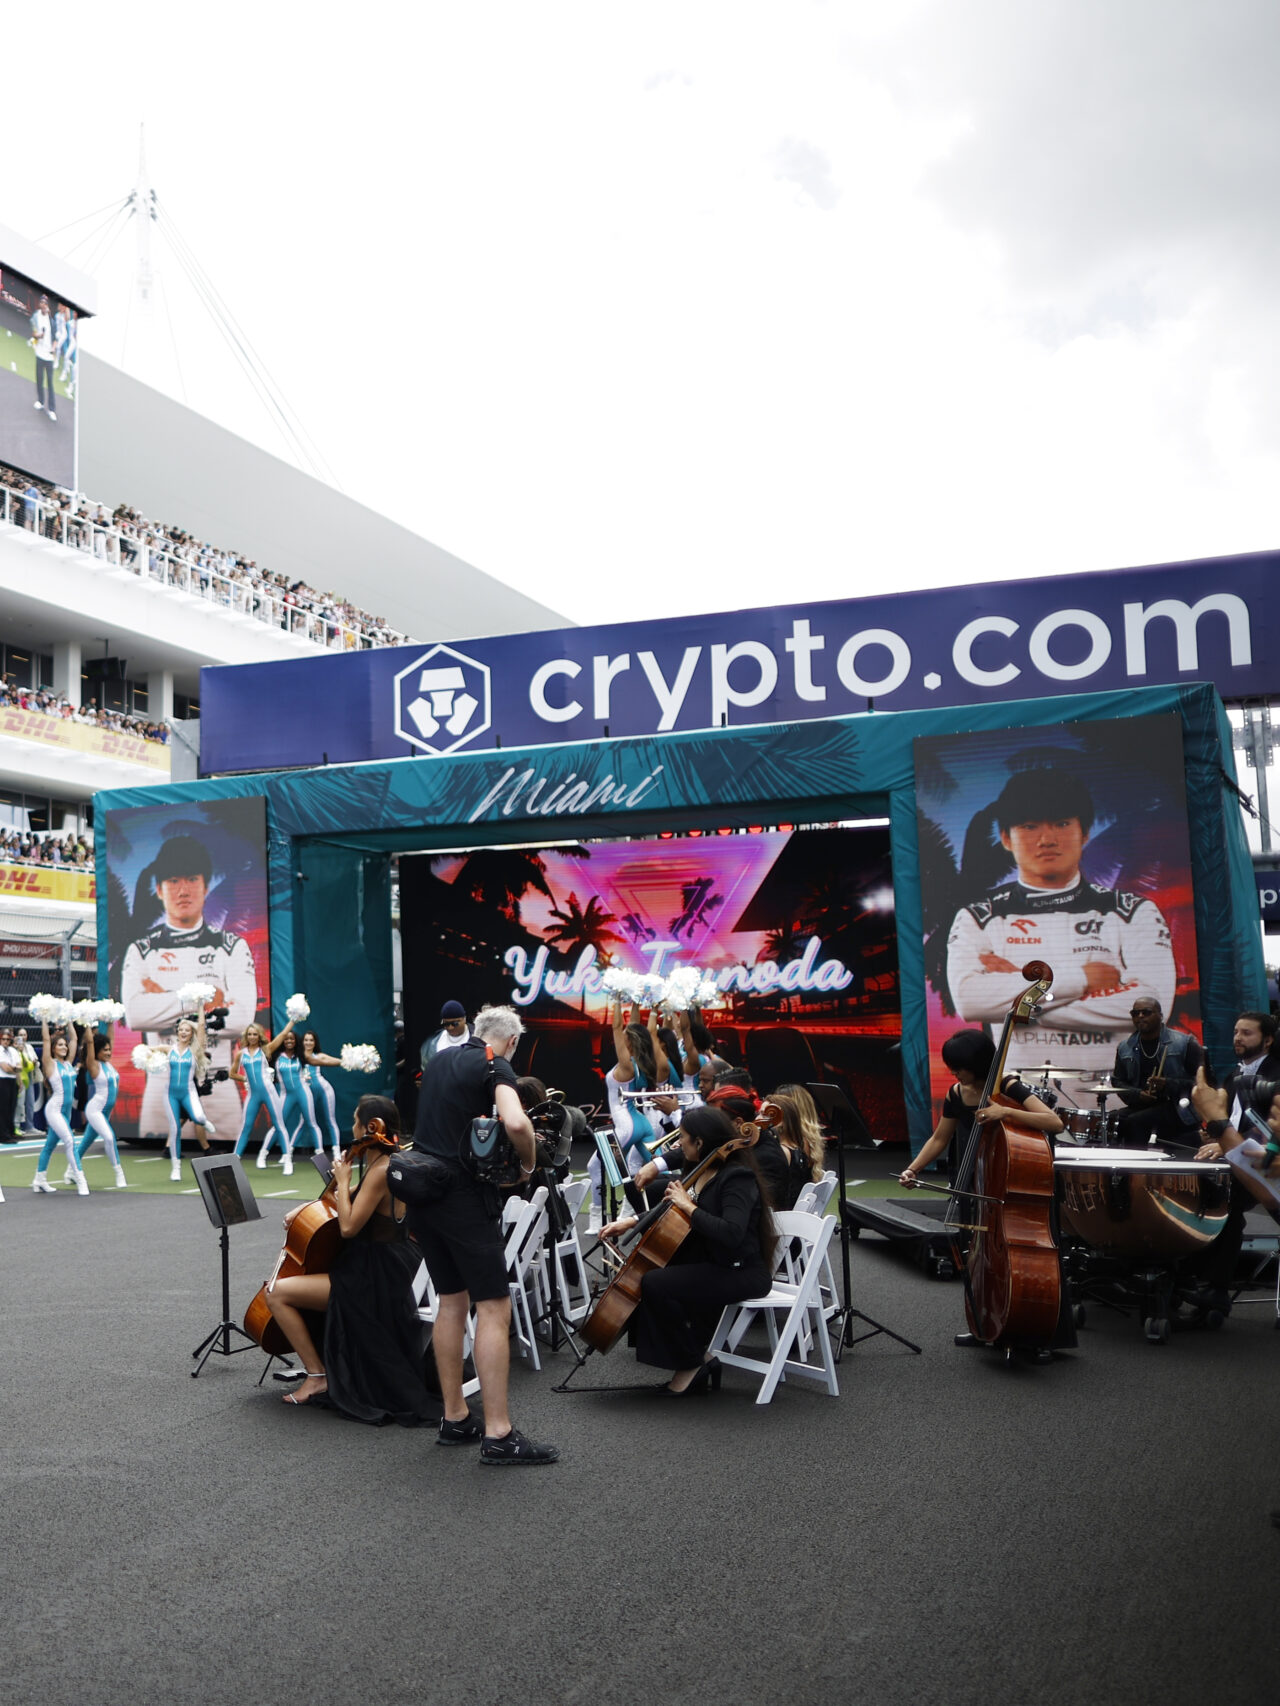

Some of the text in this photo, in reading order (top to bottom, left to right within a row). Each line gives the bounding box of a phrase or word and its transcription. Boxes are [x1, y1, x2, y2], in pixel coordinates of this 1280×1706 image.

[529, 593, 1254, 730] crypto.com
[3, 712, 61, 741] DHL
[101, 735, 150, 761] DHL
[468, 765, 664, 824] Miami
[1006, 936, 1042, 945] ORLEN
